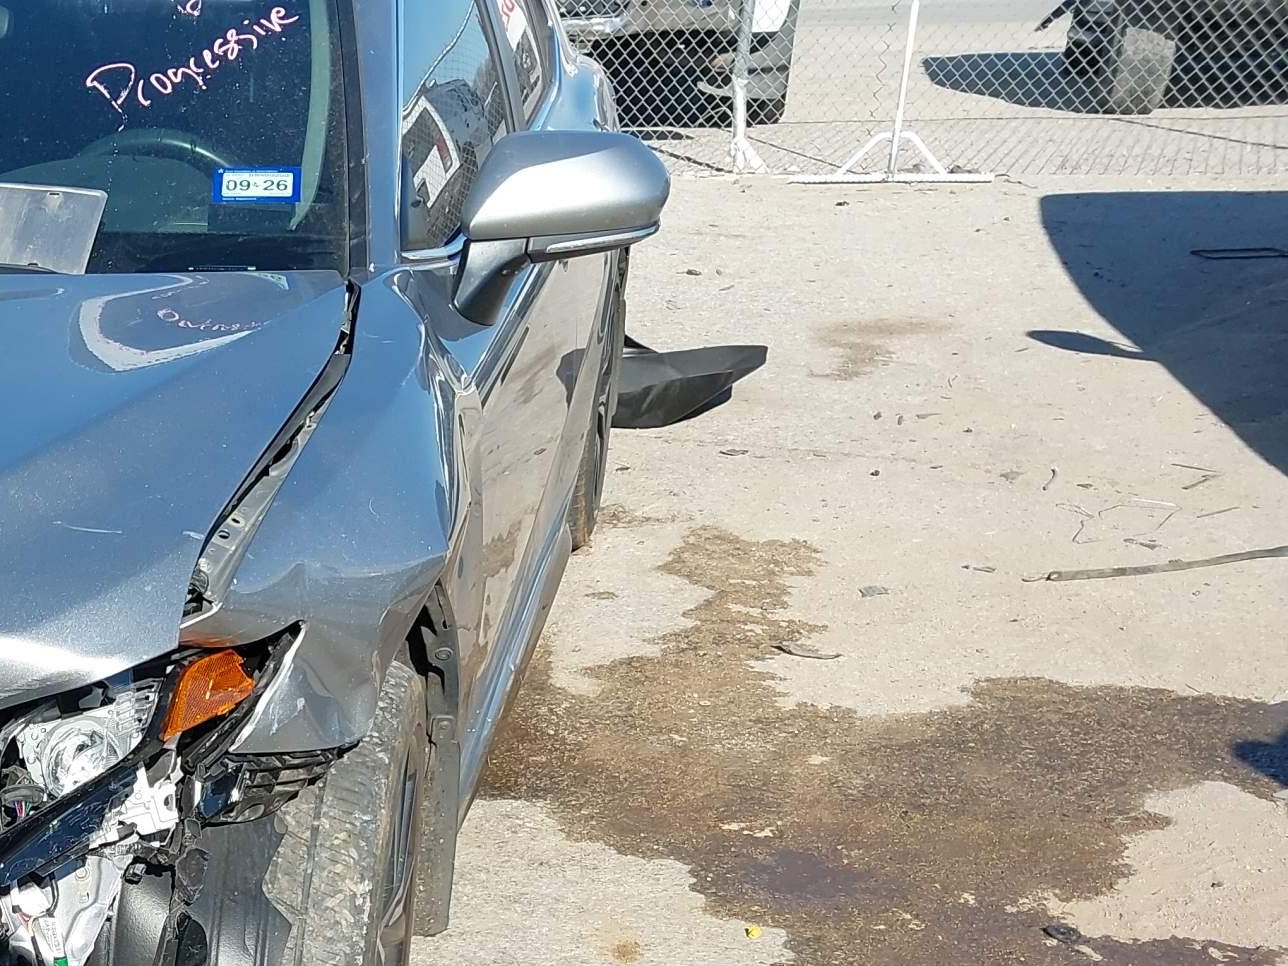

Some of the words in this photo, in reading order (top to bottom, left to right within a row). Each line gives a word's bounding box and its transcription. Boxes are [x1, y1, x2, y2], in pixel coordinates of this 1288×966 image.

[86, 6, 300, 132] Progressive
[225, 179, 251, 191] 09
[263, 179, 289, 191] 26
